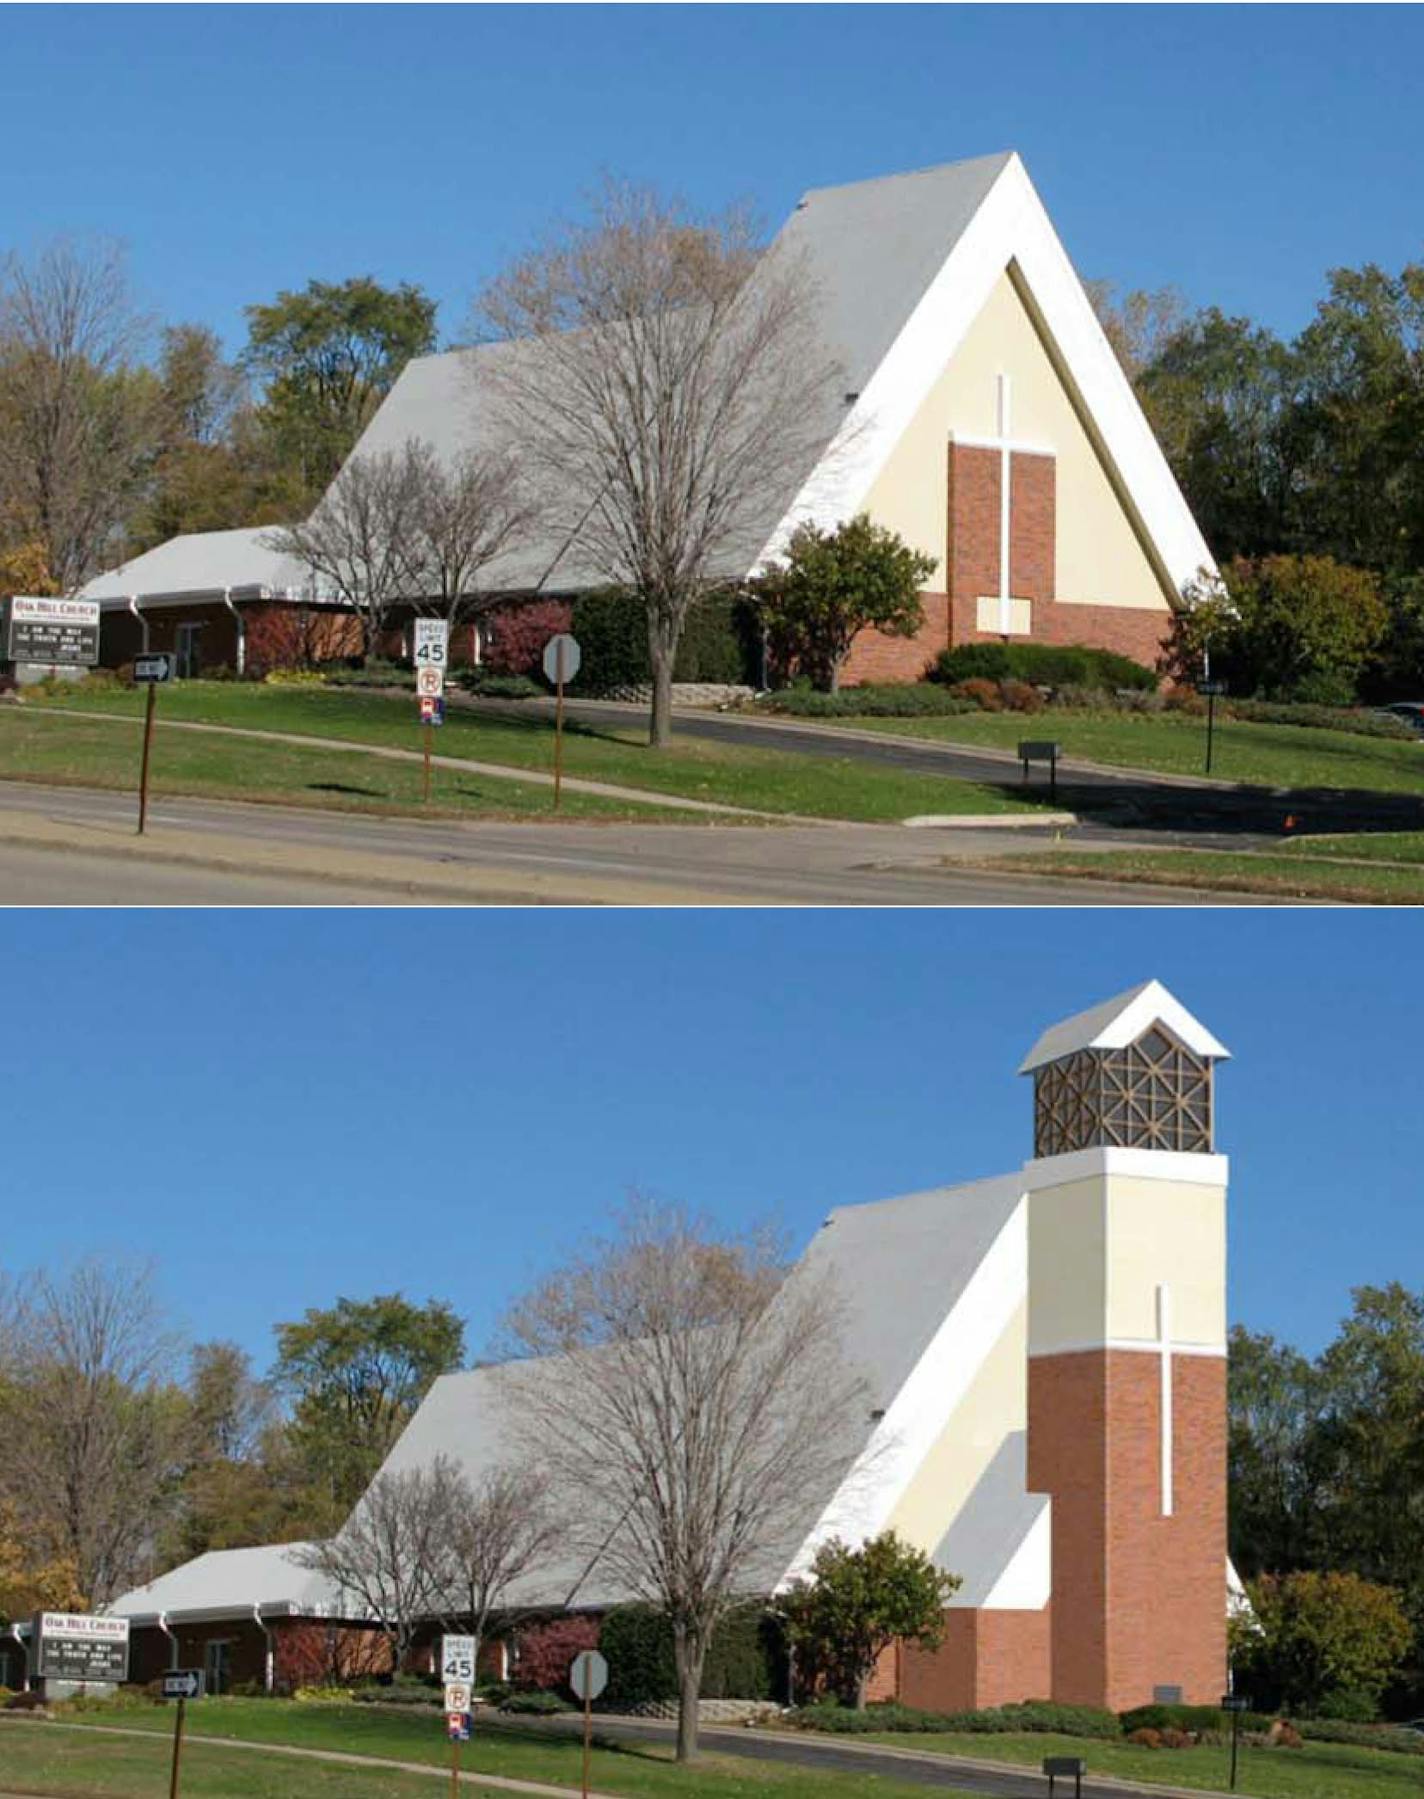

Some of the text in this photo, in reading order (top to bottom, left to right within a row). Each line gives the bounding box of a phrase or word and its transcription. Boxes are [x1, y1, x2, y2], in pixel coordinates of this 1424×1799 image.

[60, 603, 97, 615] CHURCH
[417, 643, 443, 661] 45
[89, 1620, 126, 1632] CHURCH
[445, 1659, 471, 1678] 45
